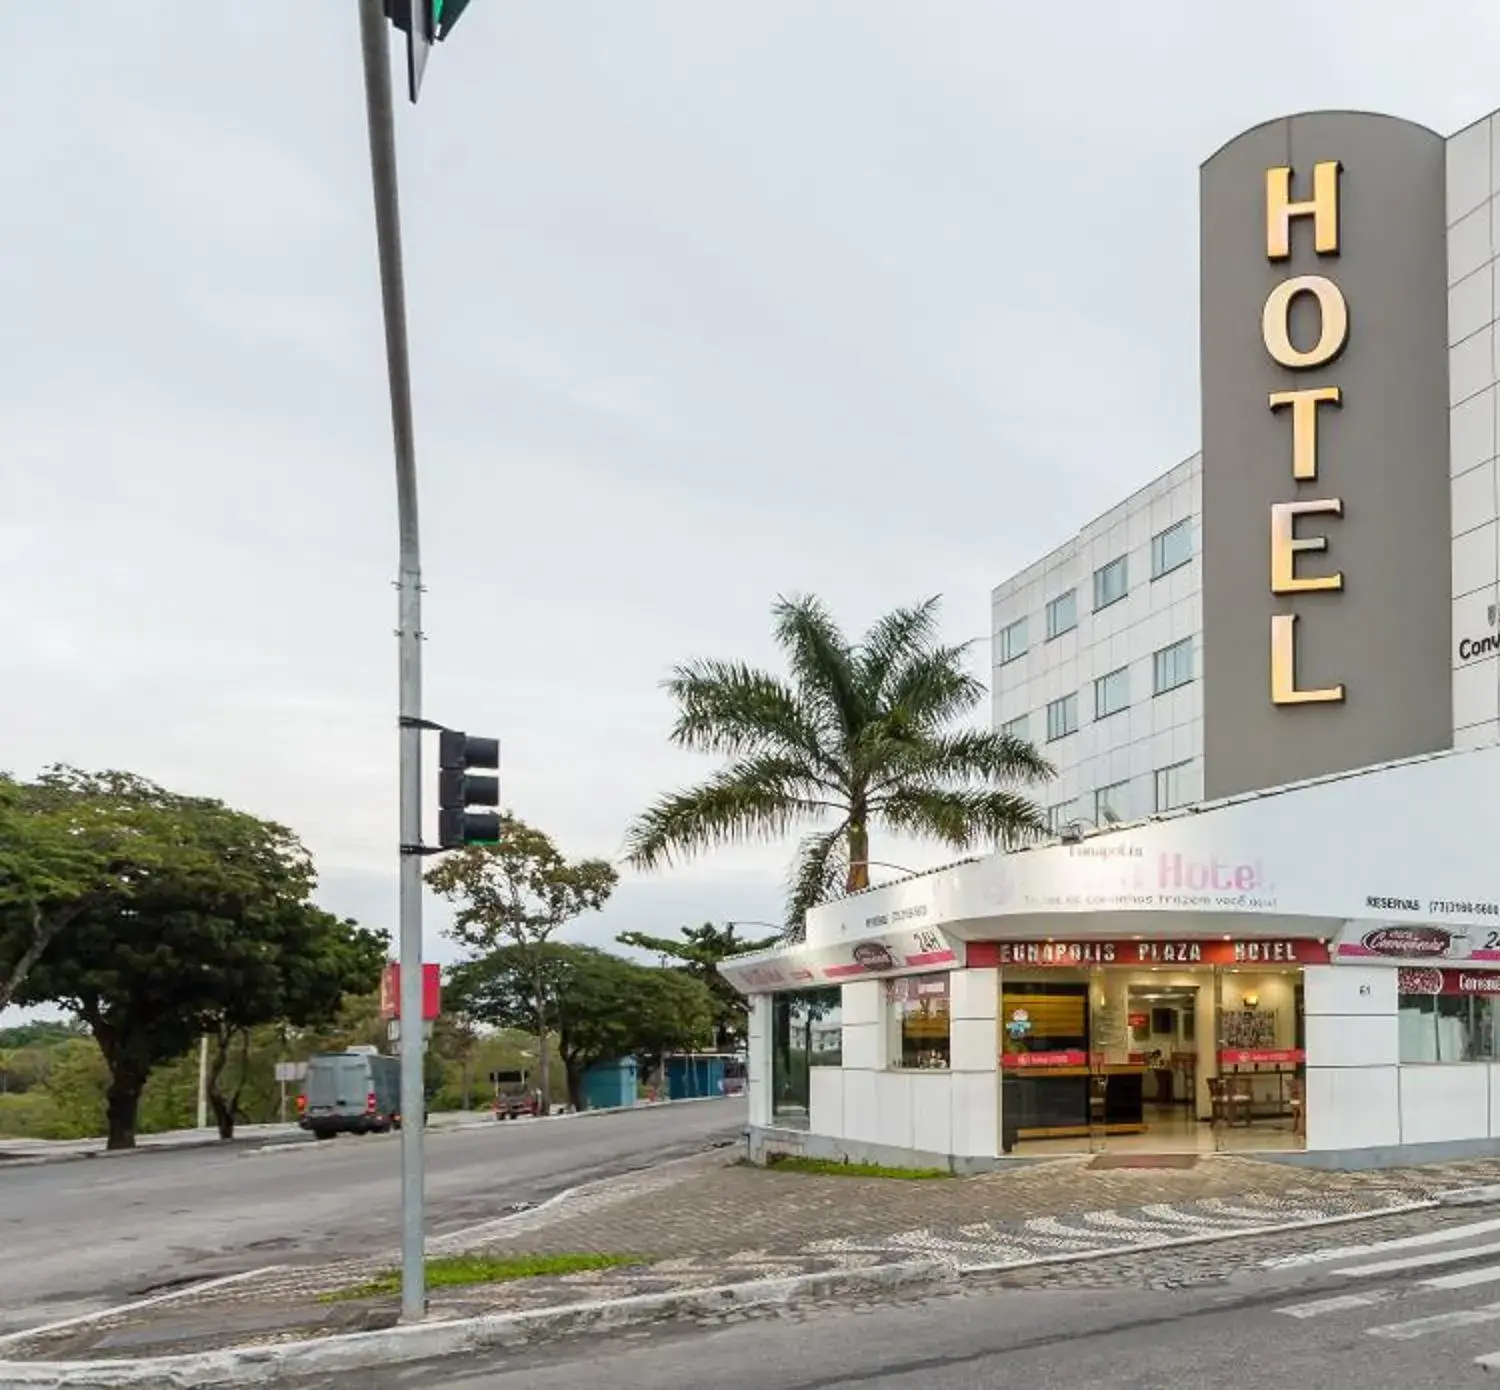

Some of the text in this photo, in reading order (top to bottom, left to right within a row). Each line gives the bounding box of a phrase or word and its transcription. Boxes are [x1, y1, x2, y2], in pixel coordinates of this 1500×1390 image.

[1261, 160, 1348, 706] HOTEL
[1139, 942, 1202, 962] PLAZA
[1235, 942, 1297, 962] HOTEL
